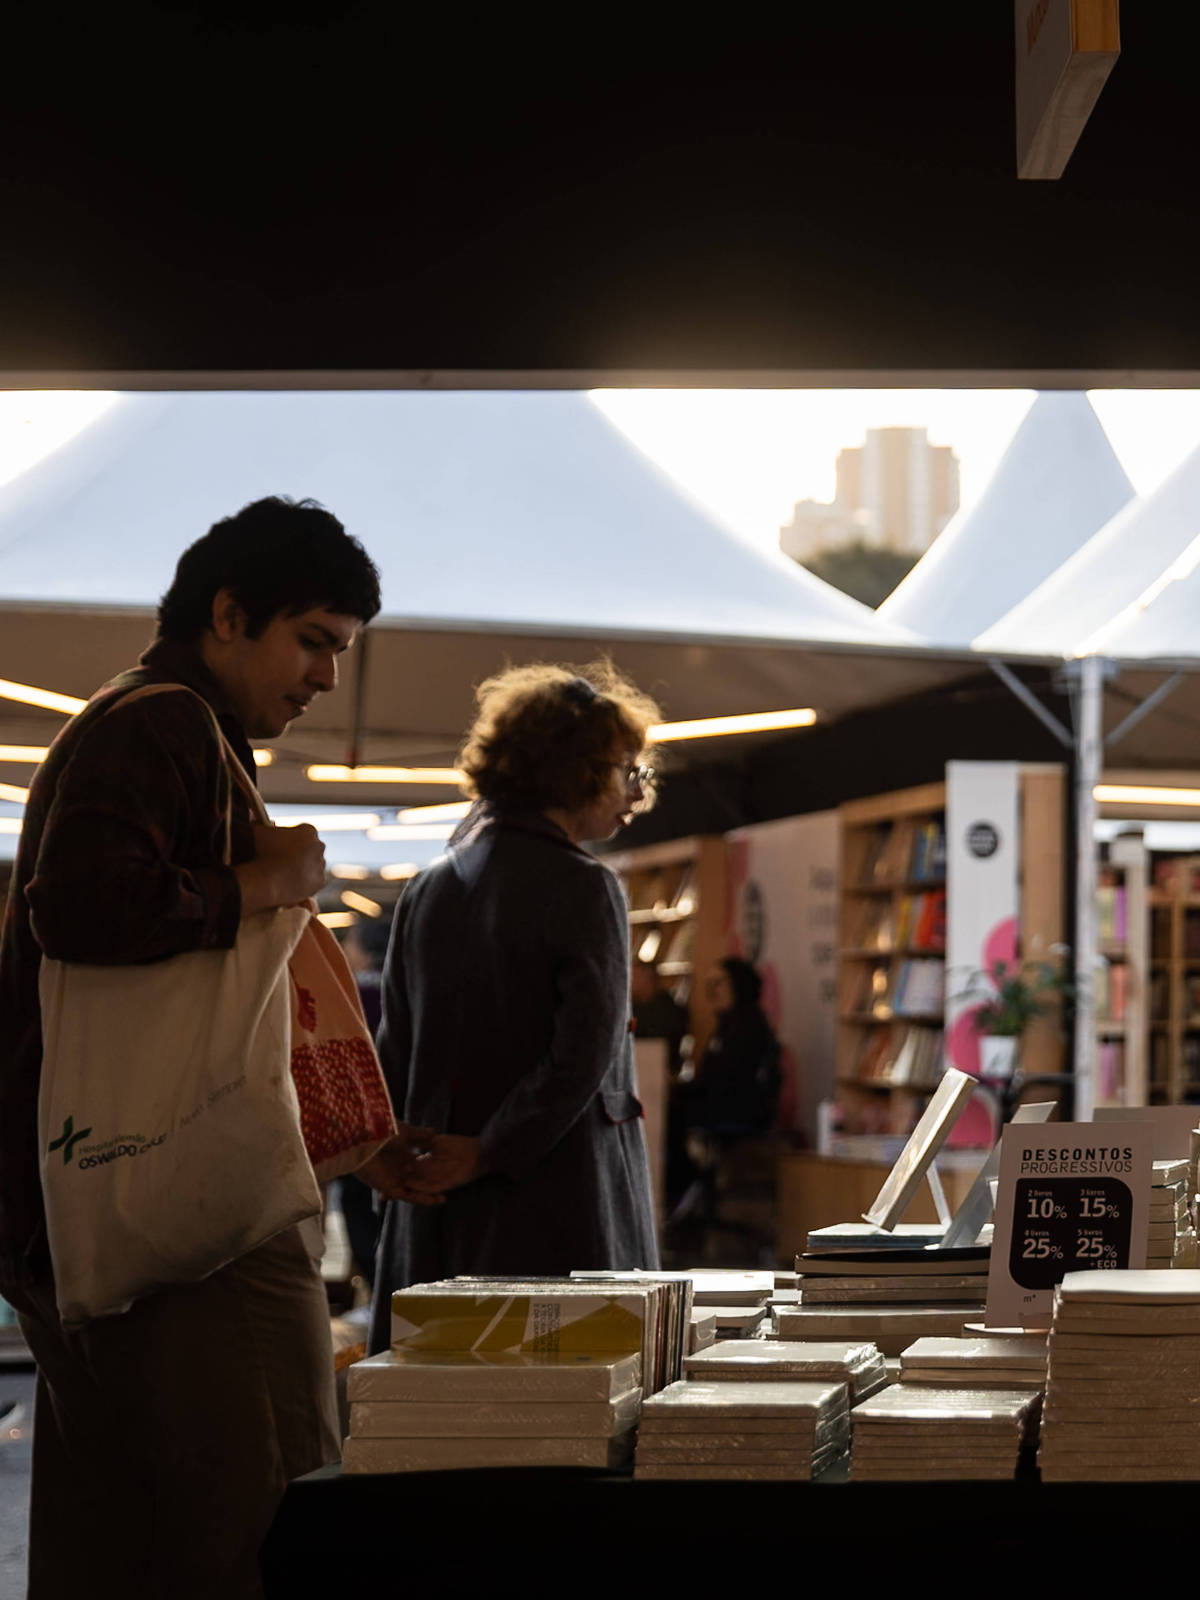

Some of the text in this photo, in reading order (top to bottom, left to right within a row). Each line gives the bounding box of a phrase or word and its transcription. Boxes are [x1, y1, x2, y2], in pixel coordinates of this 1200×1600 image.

[1022, 1148, 1133, 1161] DESCONTOS
[1020, 1161, 1133, 1174] PROGRESSIVOS
[1026, 1198, 1068, 1219] 10%
[1079, 1197, 1120, 1219] 15%
[1022, 1238, 1064, 1259] 25%
[1075, 1237, 1118, 1259] 25%
